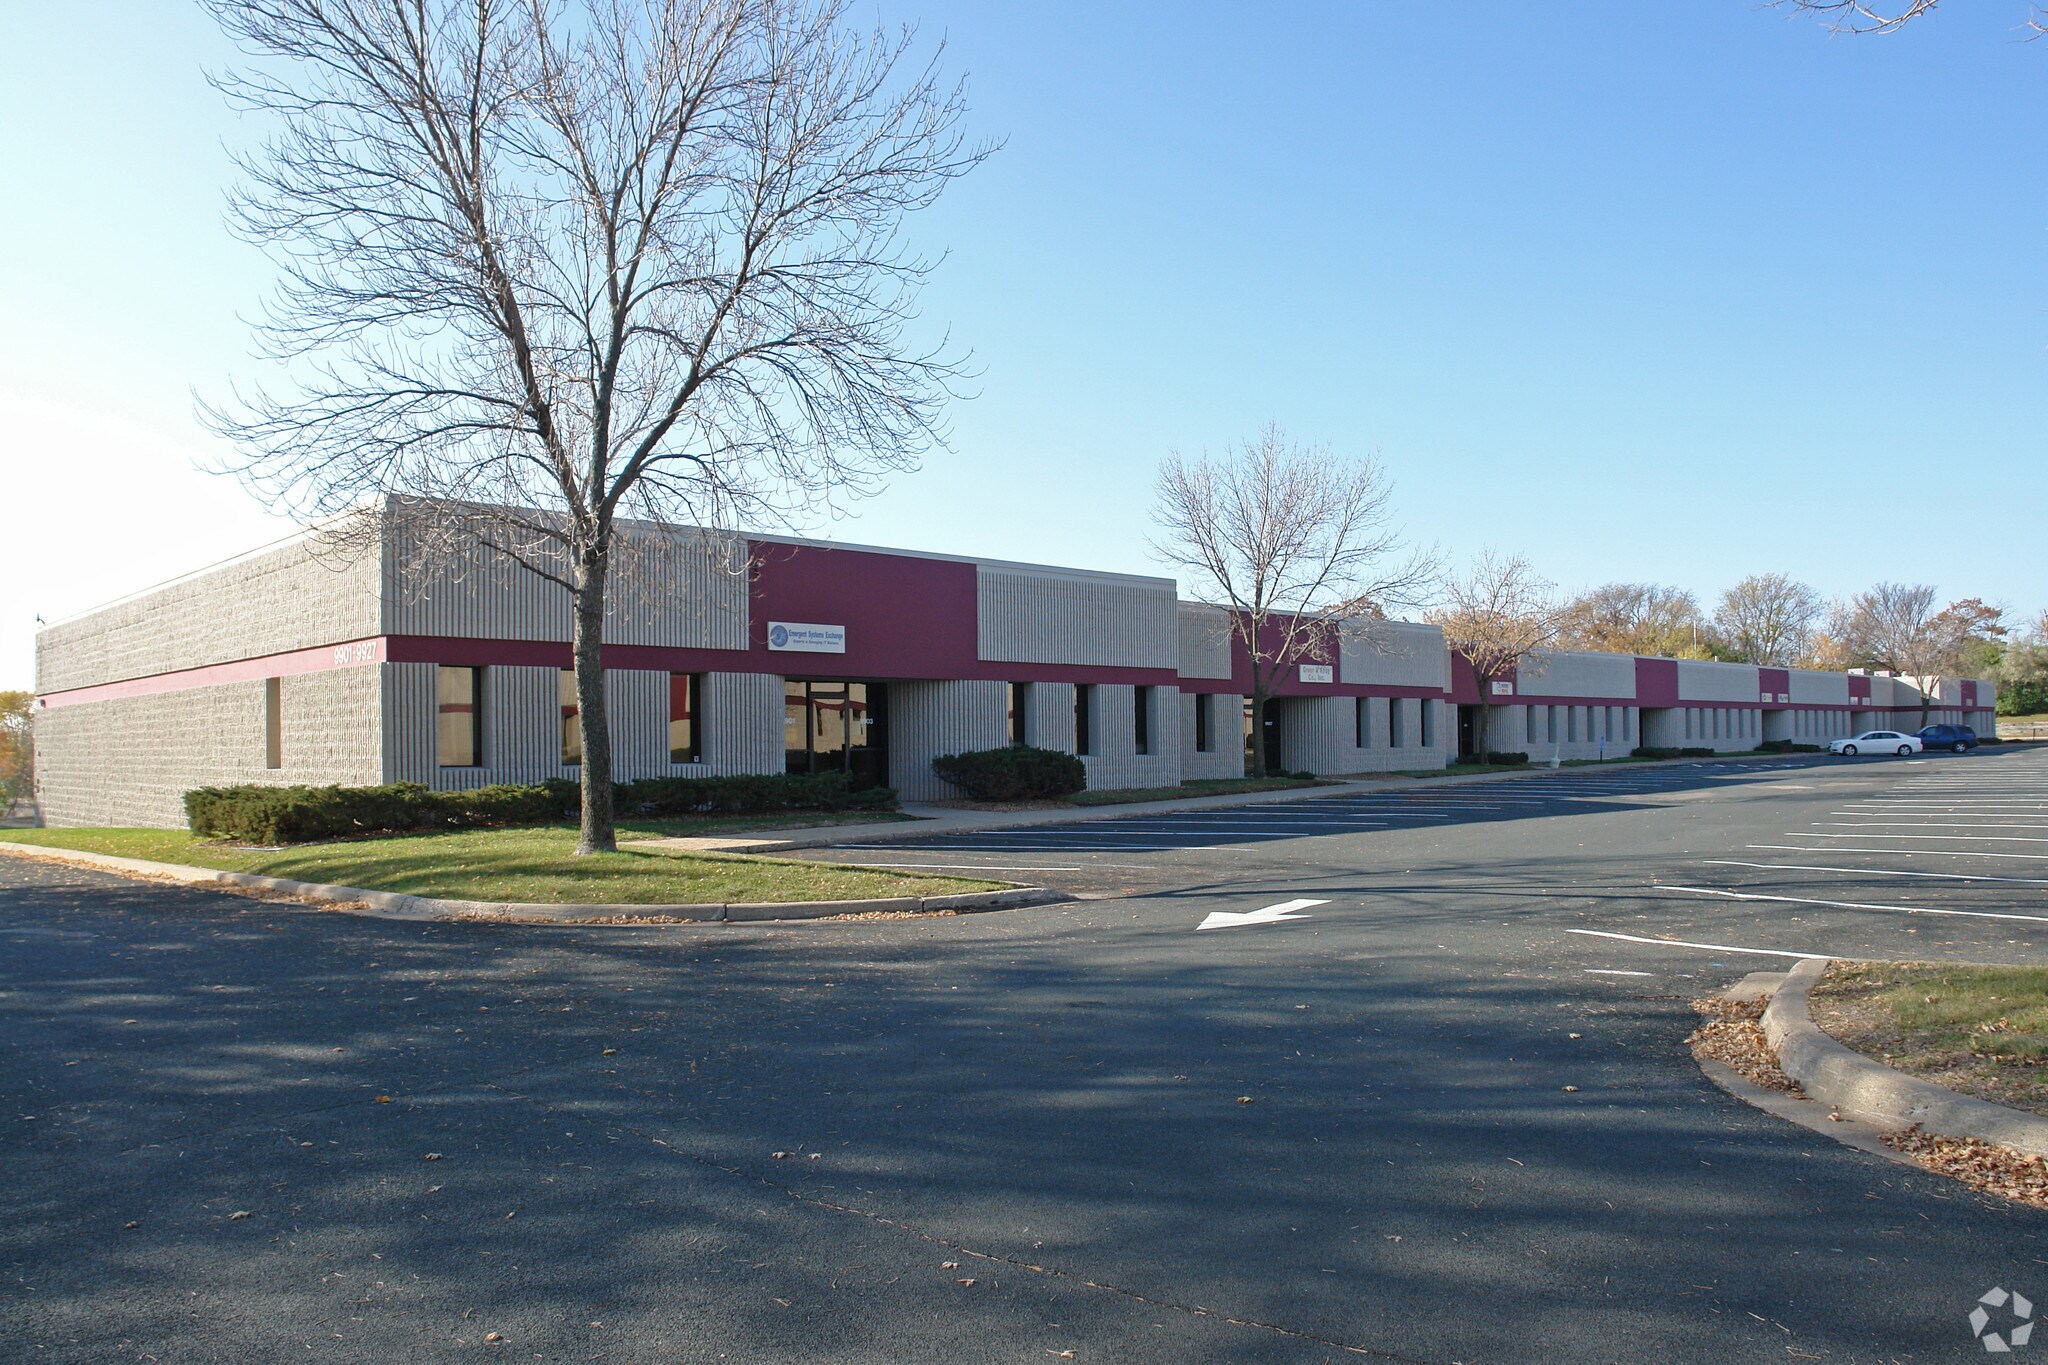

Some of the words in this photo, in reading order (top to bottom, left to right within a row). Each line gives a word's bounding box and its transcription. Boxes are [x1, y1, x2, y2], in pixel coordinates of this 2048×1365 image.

[788, 630, 807, 638] Emergent
[808, 630, 824, 640] Systems
[826, 632, 844, 640] Exchange
[334, 641, 377, 665] 9901-9927
